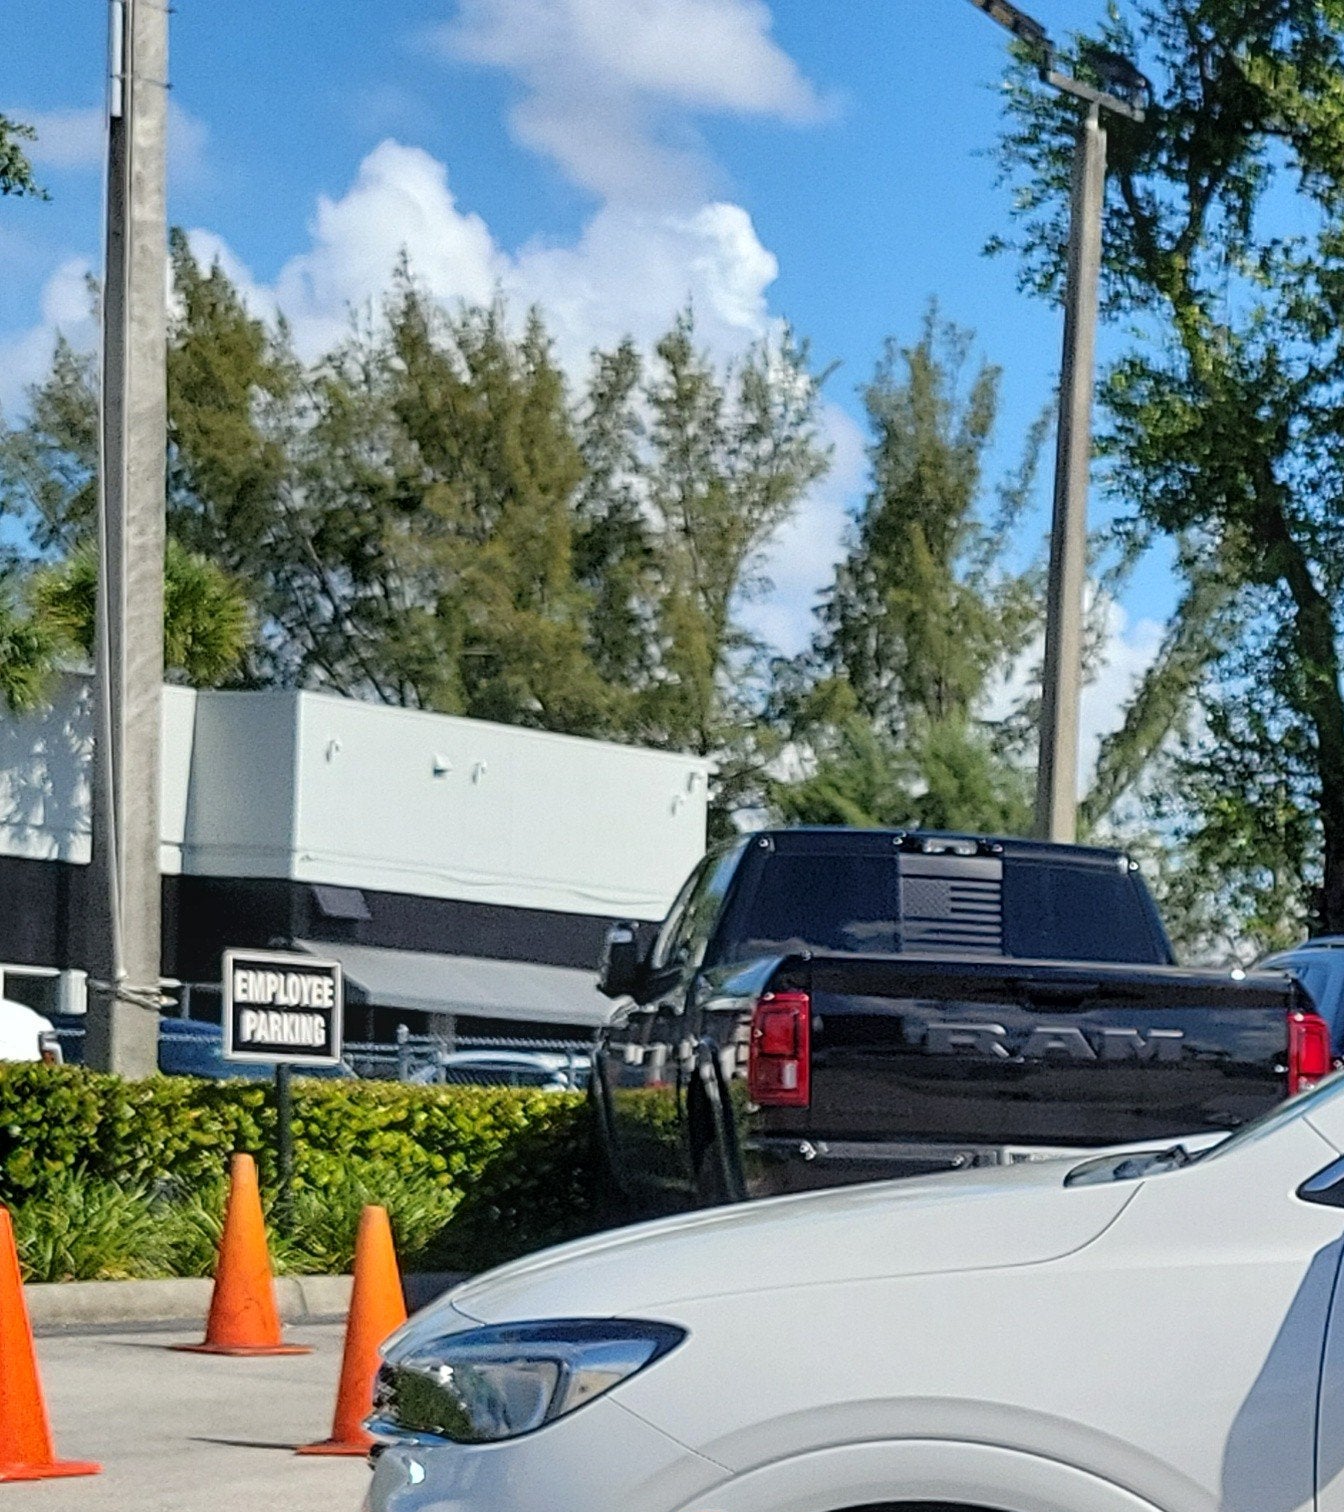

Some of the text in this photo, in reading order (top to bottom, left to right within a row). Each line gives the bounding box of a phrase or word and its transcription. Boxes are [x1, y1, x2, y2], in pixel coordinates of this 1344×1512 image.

[234, 969, 335, 1009] EMPLOYEE
[240, 1009, 326, 1047] PARKING
[922, 1021, 1185, 1063] RAM
